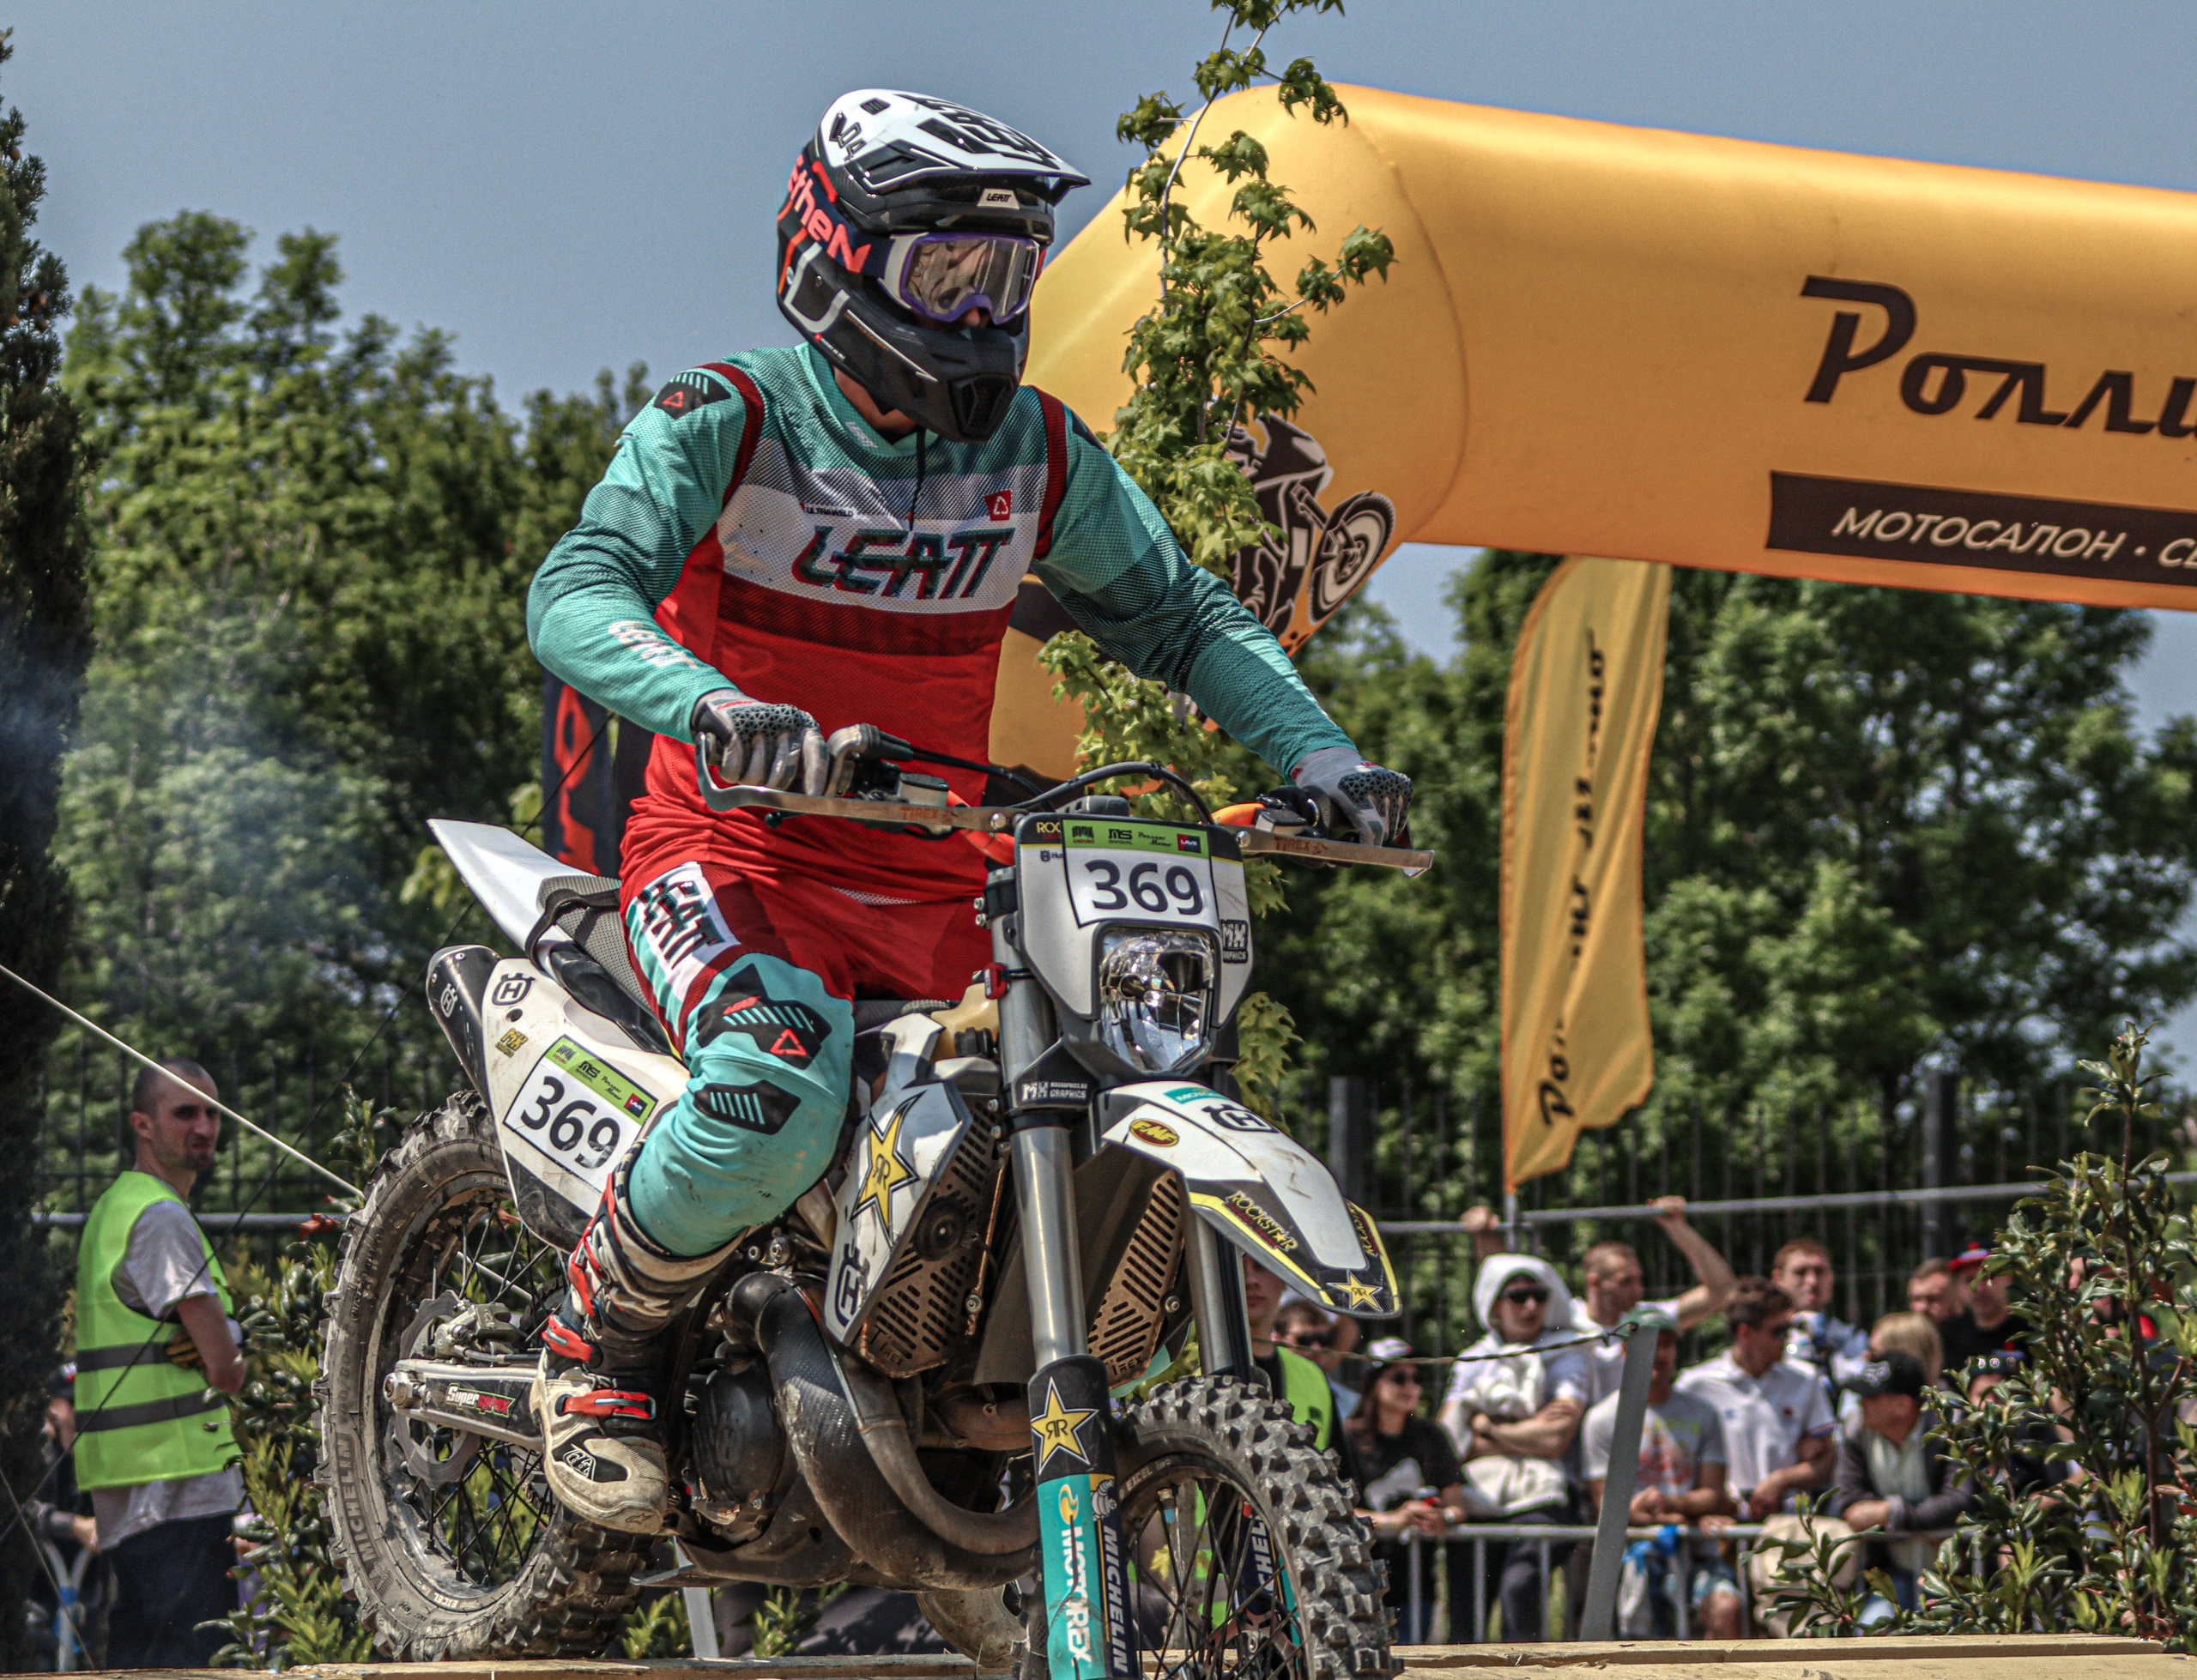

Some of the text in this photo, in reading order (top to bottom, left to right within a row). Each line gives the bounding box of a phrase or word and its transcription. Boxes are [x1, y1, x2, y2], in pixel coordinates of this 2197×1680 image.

[986, 192, 1013, 202] LEATT
[1832, 507, 2127, 561] МОТОСАЛОН
[791, 525, 1014, 601] LEATT
[1084, 859, 1203, 916] 369
[520, 1076, 621, 1169] 369
[1129, 1121, 1178, 1144] FMF
[336, 1438, 377, 1562] MICHELIN
[1126, 1466, 1153, 1491] EXCEL
[433, 1592, 459, 1609] EXCEL
[1061, 1526, 1092, 1667] MOTOREX
[1103, 1525, 1129, 1673] MICHELIN
